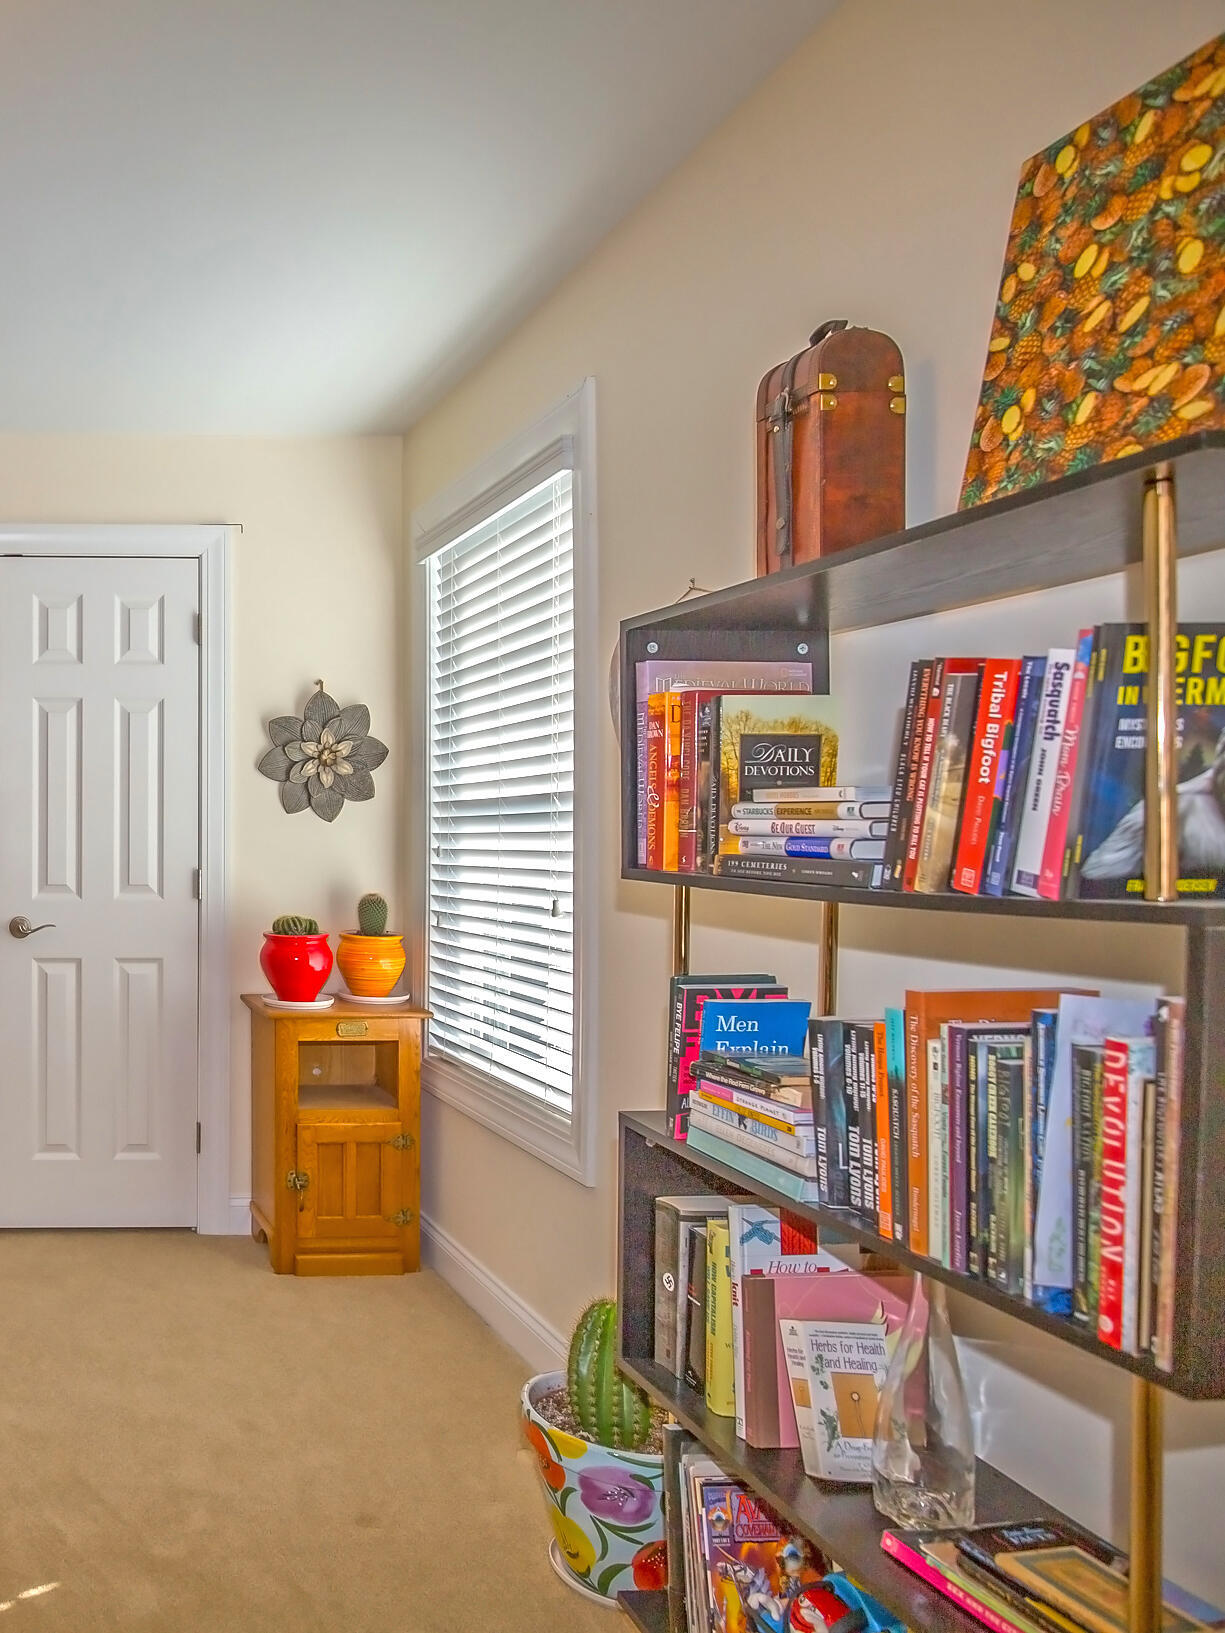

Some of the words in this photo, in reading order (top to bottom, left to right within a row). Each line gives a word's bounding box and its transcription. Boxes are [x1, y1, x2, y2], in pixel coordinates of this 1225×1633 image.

[917, 667, 931, 718] EVERYTHING
[988, 671, 1008, 718] Tribal
[1043, 662, 1070, 741] Sasquatch
[943, 697, 952, 717] BLACK
[684, 720, 691, 730] DA
[916, 718, 924, 736] YOU
[927, 717, 935, 732] HOW
[683, 732, 691, 757] VINCI
[912, 737, 922, 760] KNOW
[923, 743, 932, 755] TELL
[978, 723, 1000, 784] Bigfoot
[649, 744, 658, 789] ANGELS
[682, 759, 690, 780] CODE
[744, 764, 815, 776] DEVOTIONS
[919, 763, 929, 779] YOUR
[1037, 748, 1047, 775] JOHN
[680, 788, 689, 805] DAN
[906, 771, 917, 801] WRONG
[918, 779, 927, 791] CAT
[1031, 778, 1043, 811] GREEN
[742, 807, 774, 816] STARBUCKS
[776, 807, 812, 816] EXPERIENCE
[914, 797, 924, 825] PLOTTING
[647, 804, 656, 850] DEMONS
[709, 802, 717, 854] DEVOTIONS
[734, 822, 749, 832] Disney
[770, 822, 779, 834] BE
[780, 822, 793, 834] OUR
[794, 822, 816, 835] GUEST
[911, 834, 919, 847] KILL
[909, 847, 917, 859] YOU
[741, 861, 788, 870] CEMETERIES
[675, 1002, 683, 1021] BYE
[715, 1015, 759, 1032] Men
[909, 1015, 918, 1033] The
[673, 1022, 681, 1054] FELIPE
[715, 1040, 789, 1055] Explain
[909, 1034, 918, 1080] Discovery
[988, 1054, 997, 1083] BOGGY
[705, 1071, 720, 1081] Where
[720, 1075, 728, 1083] the
[728, 1078, 738, 1086] Red
[738, 1080, 750, 1090] Fern
[911, 1082, 920, 1095] of
[911, 1096, 920, 1109] the
[954, 1088, 962, 1125] Encounters
[988, 1083, 997, 1113] CREEK
[891, 1088, 900, 1140] SASQUATCH
[751, 1120, 778, 1141] BIRDS
[817, 1127, 827, 1154] Tom
[848, 1125, 860, 1158] Tom
[910, 1112, 921, 1158] Sasquatch
[988, 1113, 997, 1158] CASEBOOK
[862, 1138, 873, 1164] Tom
[1101, 1049, 1127, 1263] DEVOLUTION
[818, 1155, 828, 1192] Lyons
[849, 1159, 861, 1206] Lyons
[863, 1164, 874, 1210] Lyons
[768, 1260, 802, 1274] How
[804, 1261, 817, 1273] to
[731, 1281, 740, 1307] knit
[810, 1338, 837, 1353] Herbs
[839, 1340, 853, 1354] for
[856, 1341, 886, 1356] Health
[824, 1358, 841, 1369] and
[843, 1356, 878, 1373] Healing
